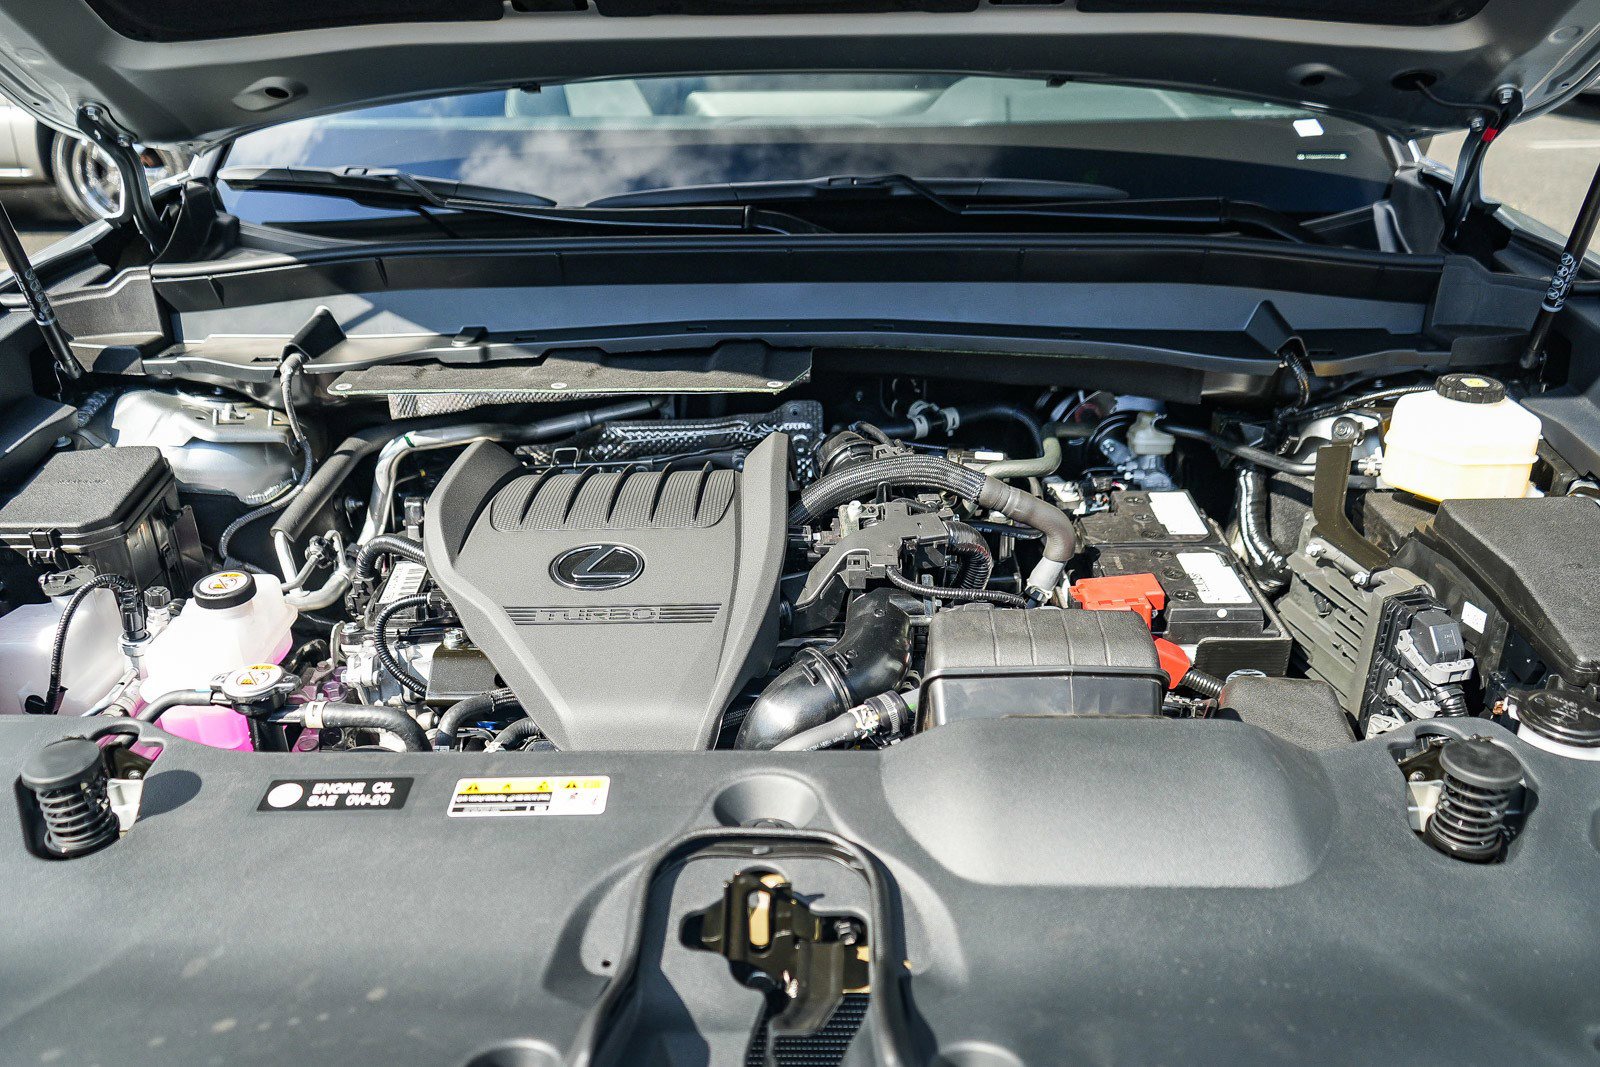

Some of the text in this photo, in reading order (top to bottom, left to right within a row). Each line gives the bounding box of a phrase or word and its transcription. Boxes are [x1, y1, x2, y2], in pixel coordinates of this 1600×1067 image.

[540, 607, 656, 621] TURBO
[312, 781, 395, 794] ENGINE OIL
[306, 794, 391, 807] SAE 0W-20
